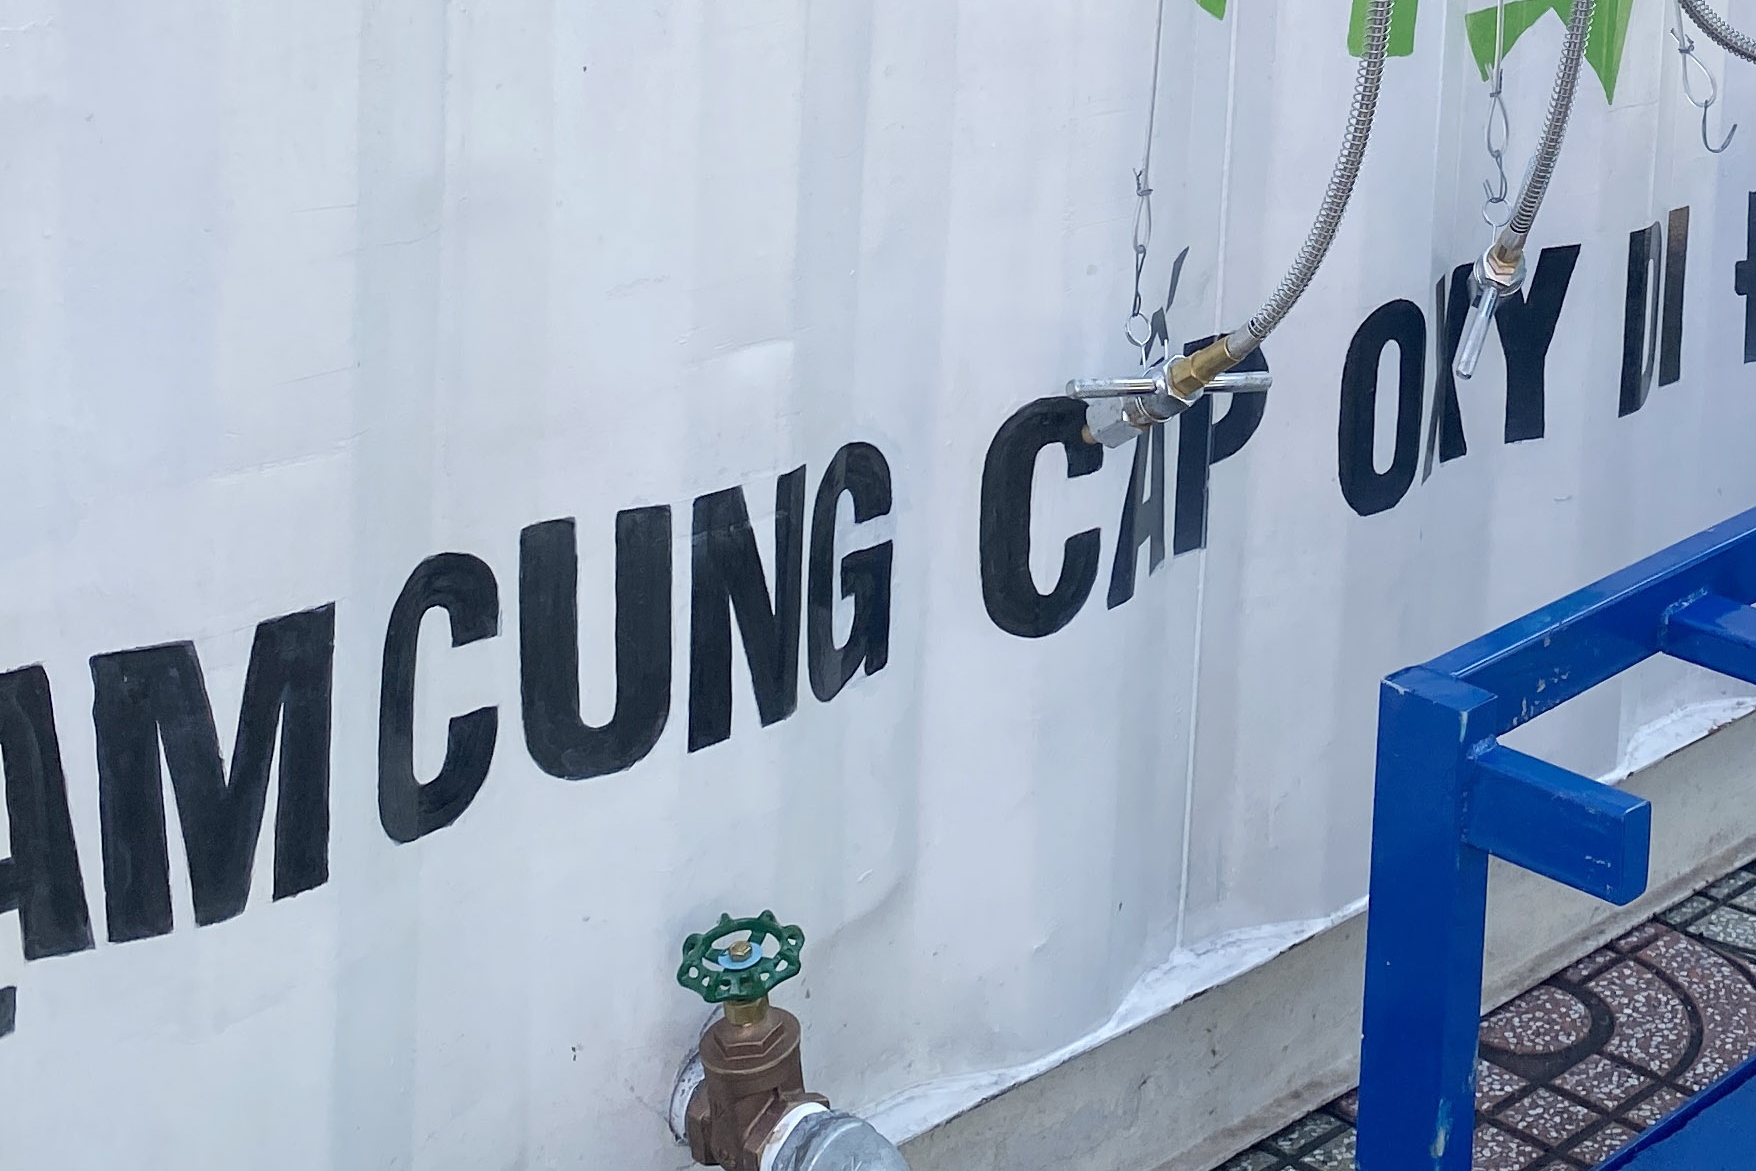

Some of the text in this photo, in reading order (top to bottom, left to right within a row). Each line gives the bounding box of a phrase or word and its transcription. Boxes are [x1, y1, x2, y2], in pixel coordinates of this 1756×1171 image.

[378, 441, 893, 846] CUNG
[1338, 243, 1582, 516] OXY
[1617, 206, 1690, 418] DI
